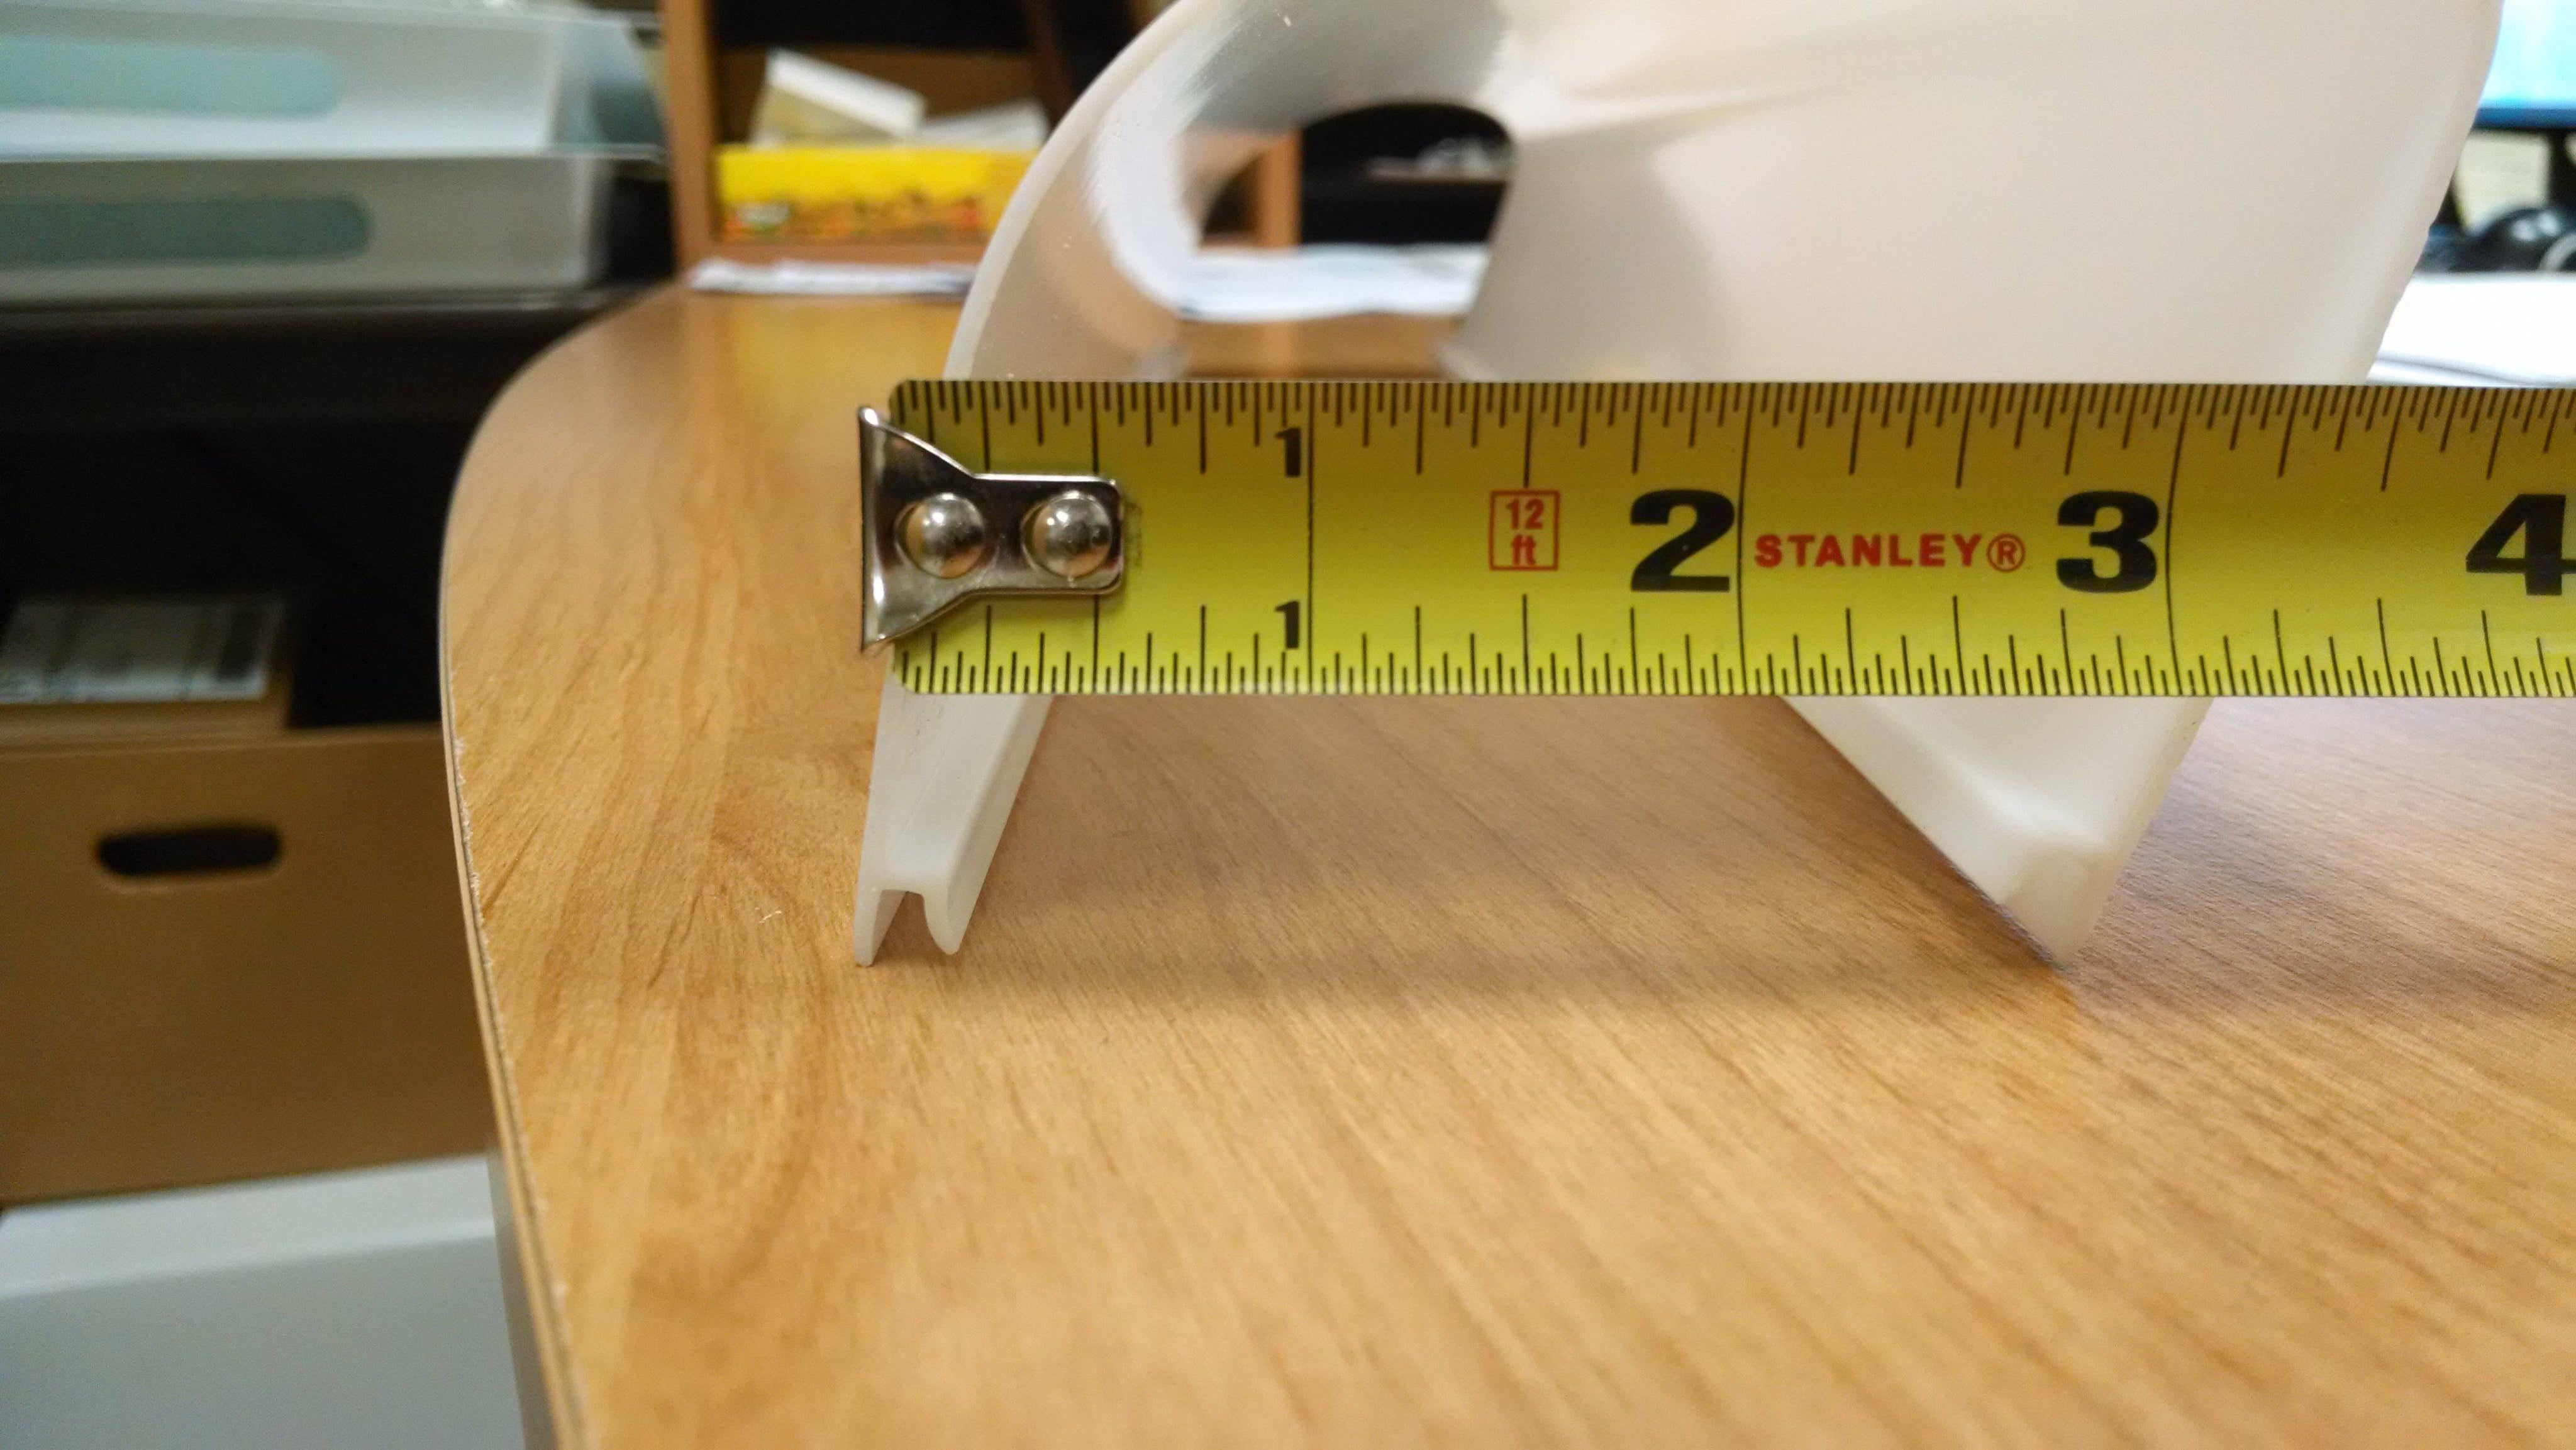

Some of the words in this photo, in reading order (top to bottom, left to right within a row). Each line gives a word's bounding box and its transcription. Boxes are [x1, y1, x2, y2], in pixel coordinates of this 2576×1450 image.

[1274, 426, 1301, 477] 1
[1506, 498, 1543, 529] 12
[1511, 534, 1537, 565] ft
[1630, 489, 1735, 592] 2
[2057, 490, 2160, 594] 3
[2465, 494, 2576, 595] 4
[1274, 600, 1299, 649] 1
